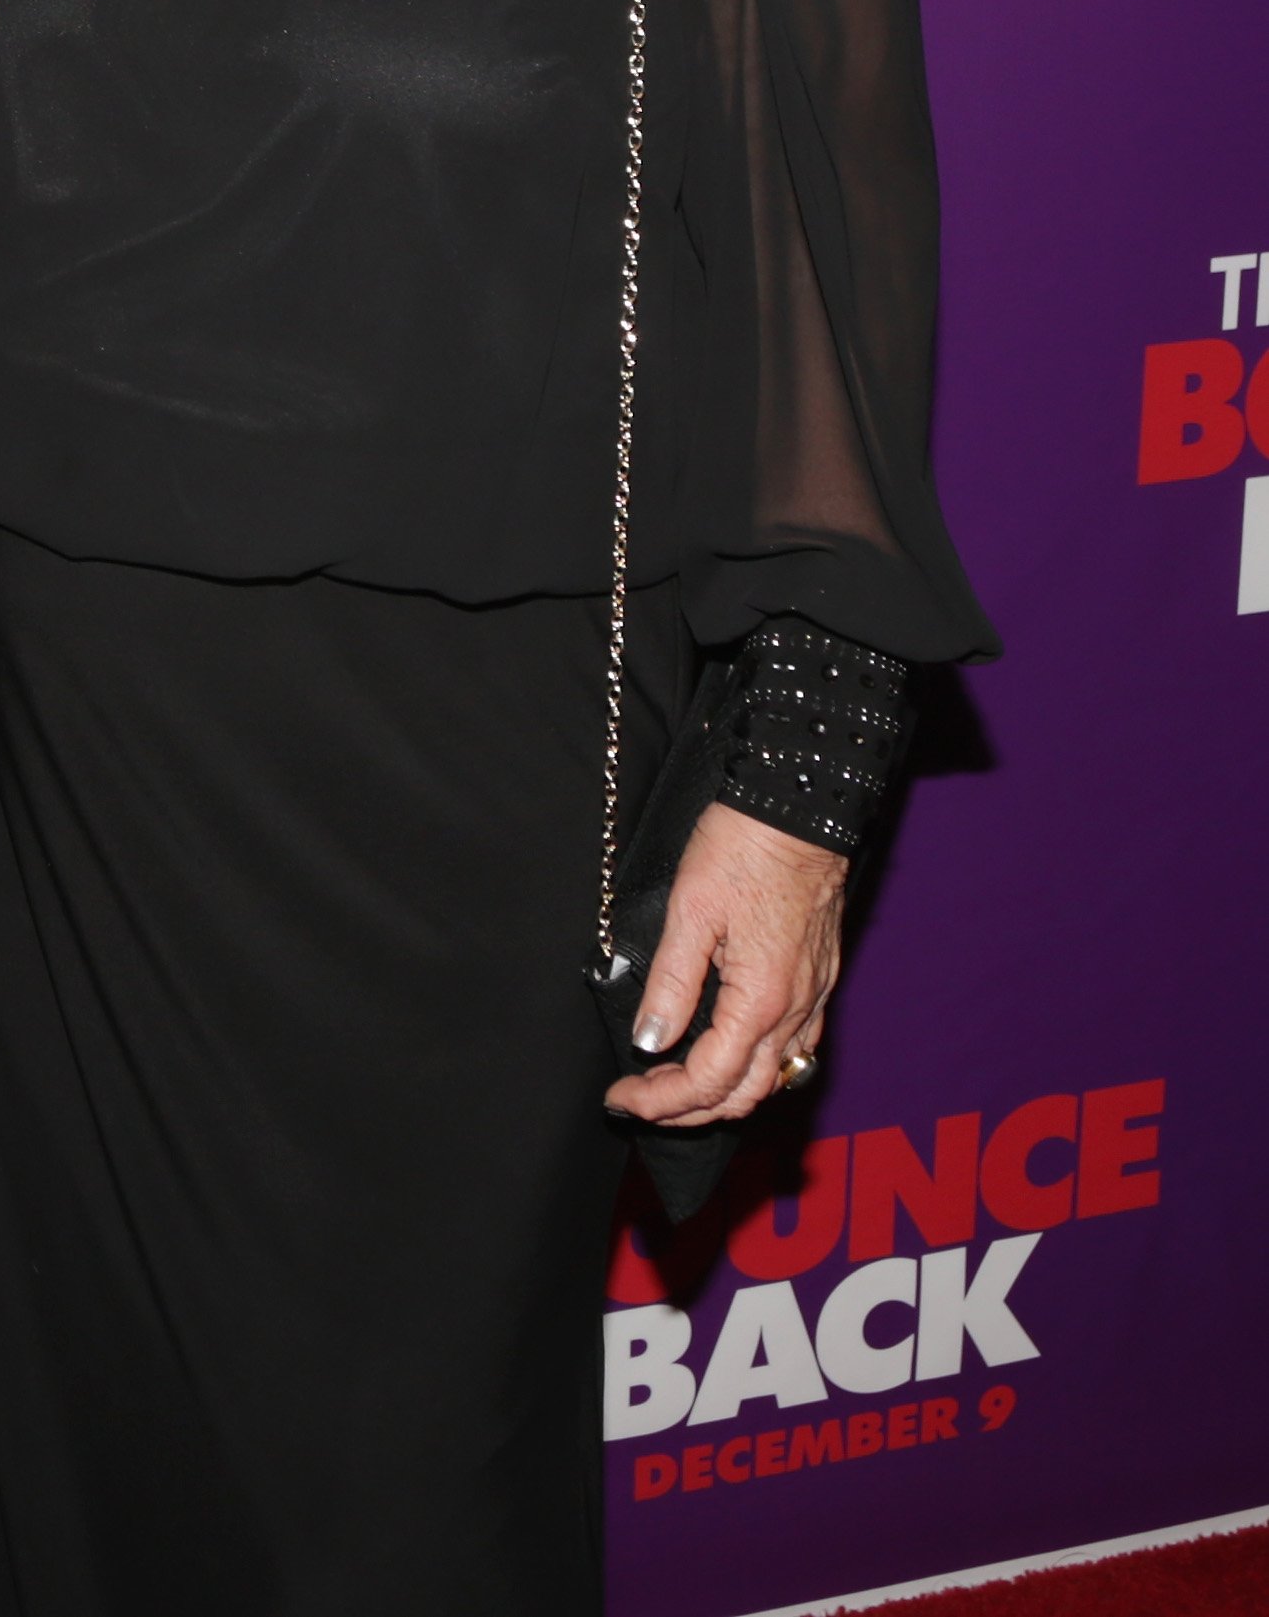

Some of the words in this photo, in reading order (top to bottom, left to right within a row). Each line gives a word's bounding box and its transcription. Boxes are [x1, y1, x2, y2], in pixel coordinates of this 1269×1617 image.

[603, 1232, 1043, 1442] BACK
[634, 1397, 960, 1502] DECEMBER
[978, 1384, 1017, 1433] 9
